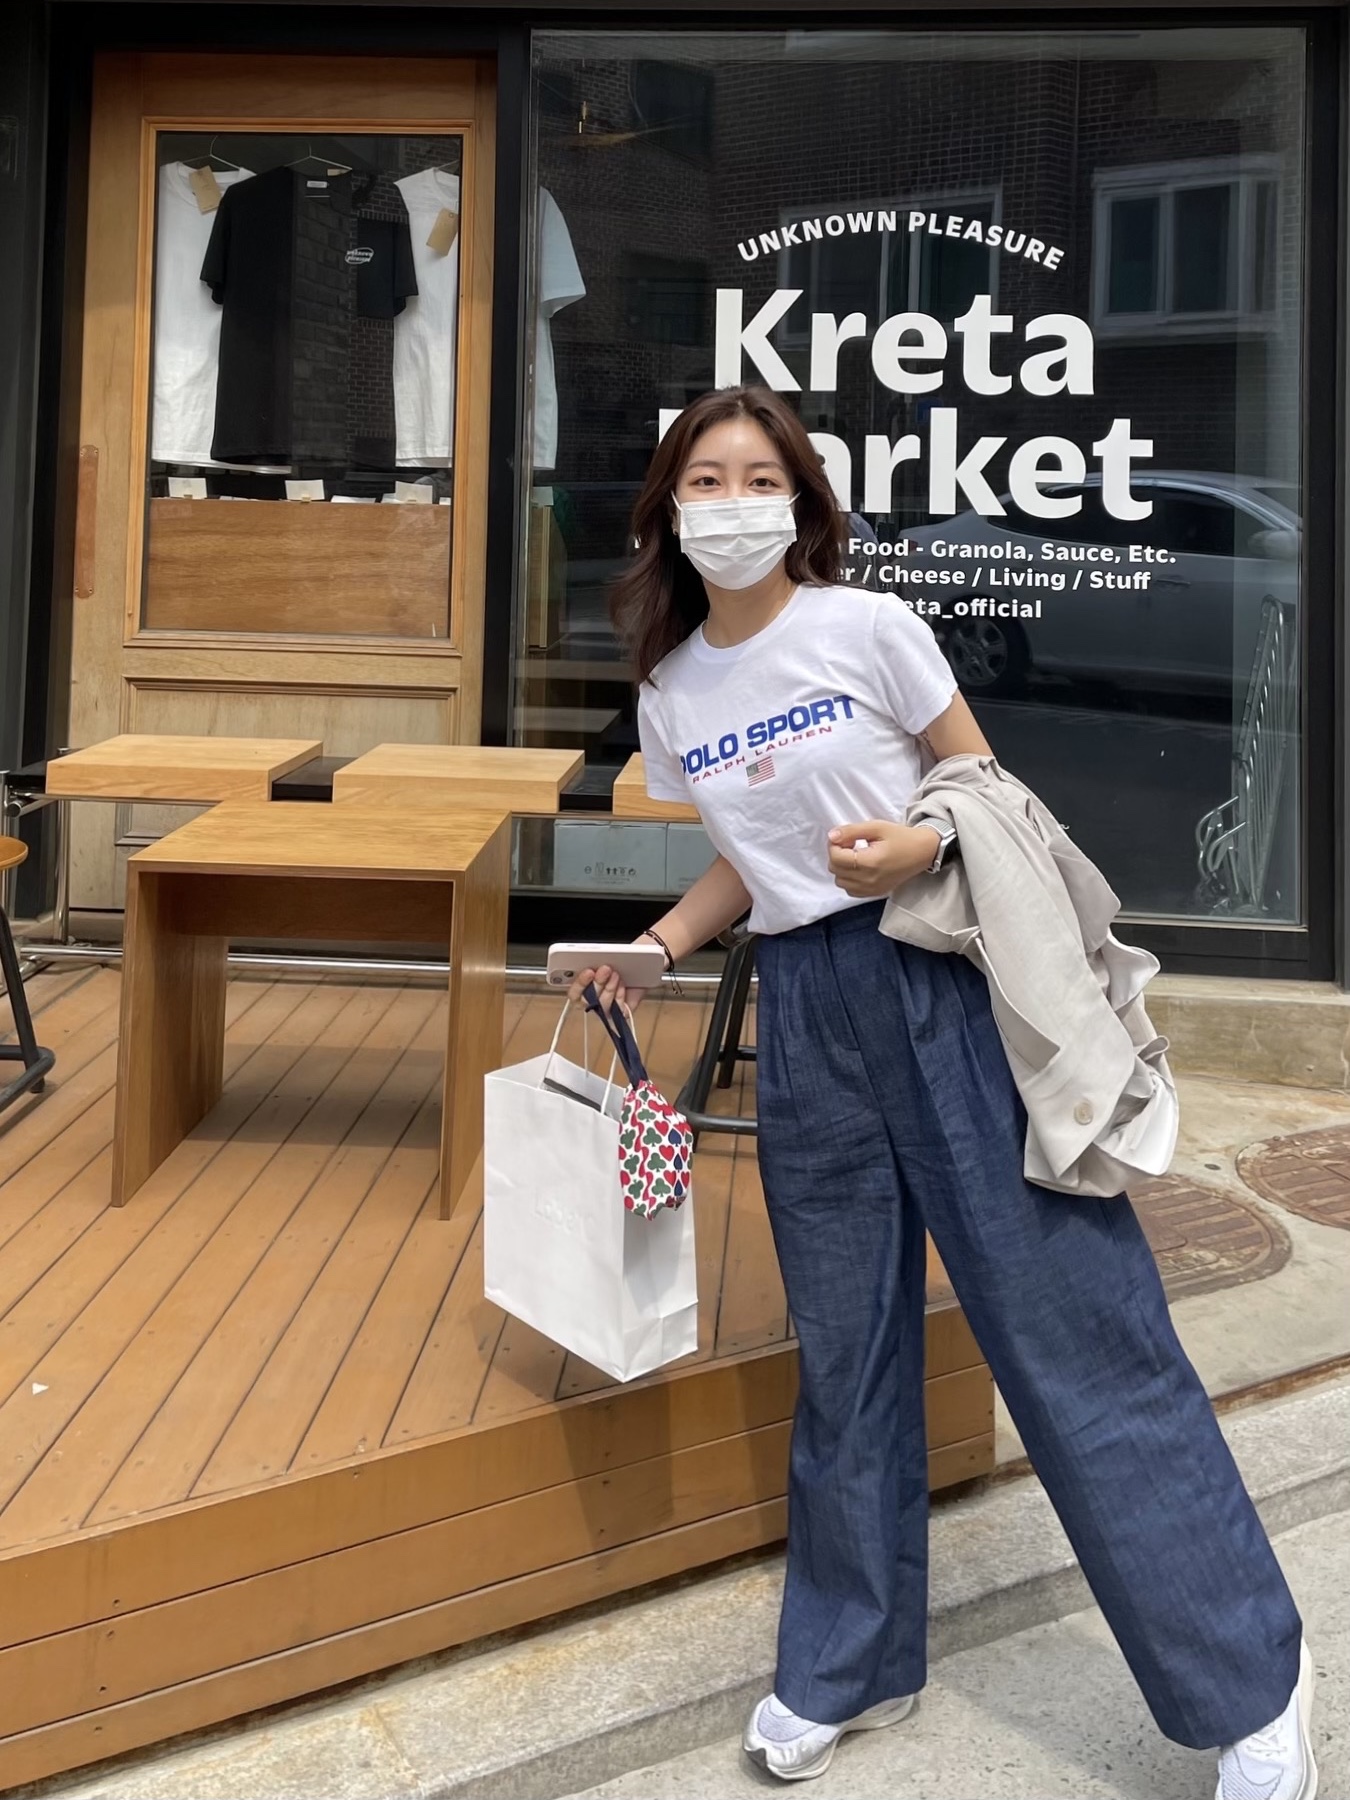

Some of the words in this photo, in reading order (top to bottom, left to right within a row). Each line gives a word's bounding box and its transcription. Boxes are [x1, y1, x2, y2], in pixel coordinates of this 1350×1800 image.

[738, 211, 897, 261] UNKNOWN
[908, 211, 1065, 271] PLEASURE
[715, 288, 1094, 396] Kreta
[659, 407, 1154, 521] arket
[848, 537, 909, 557] Food
[930, 539, 1034, 562] Granola,
[1040, 542, 1121, 564] Sauce,
[1128, 544, 1177, 565] Etc.
[878, 565, 966, 585] Cheese
[989, 568, 1066, 591] Living
[1089, 570, 1151, 590] Stuff
[680, 733, 739, 775] OLO
[746, 694, 855, 749] SPORT
[692, 756, 747, 784] RALPH
[755, 725, 833, 757] LAUREN
